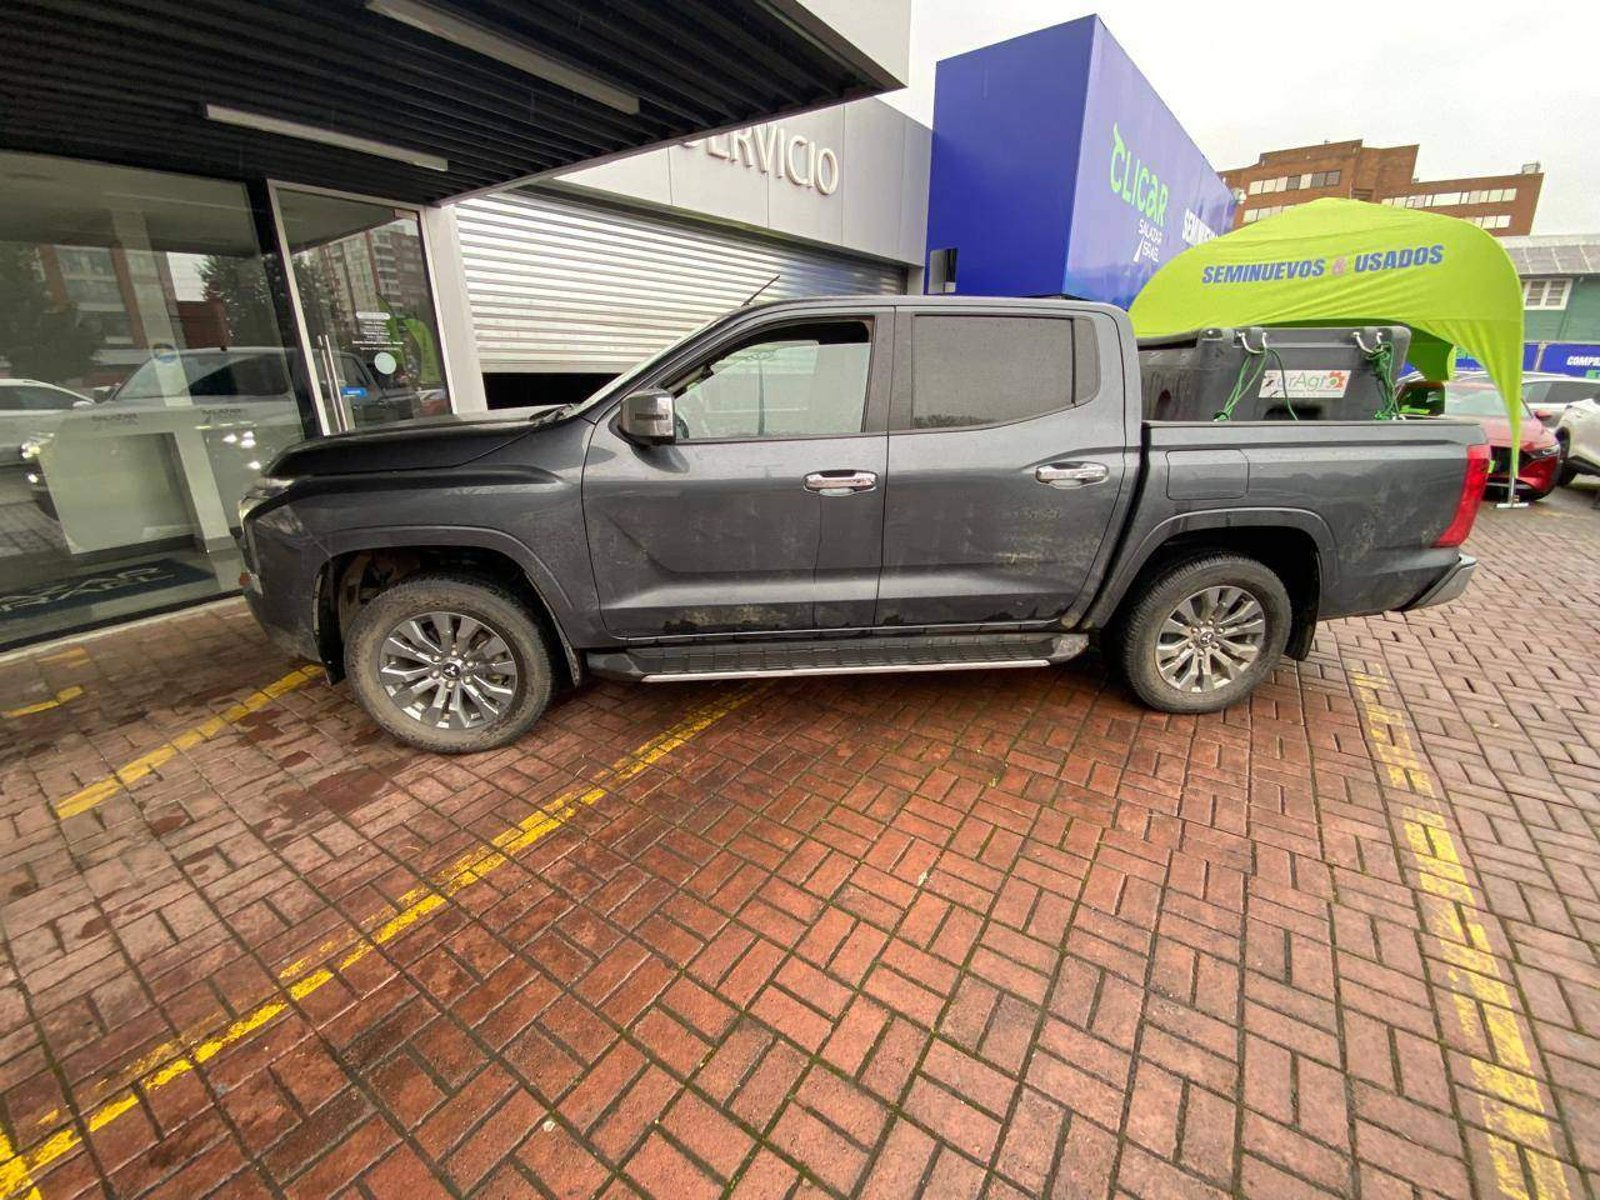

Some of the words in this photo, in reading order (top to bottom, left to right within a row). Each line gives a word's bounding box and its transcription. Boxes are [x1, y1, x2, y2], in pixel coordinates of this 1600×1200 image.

[680, 122, 838, 195] ERVICIO
[1202, 258, 1326, 284] SEMINUEVOS
[1354, 244, 1445, 274] USADOS
